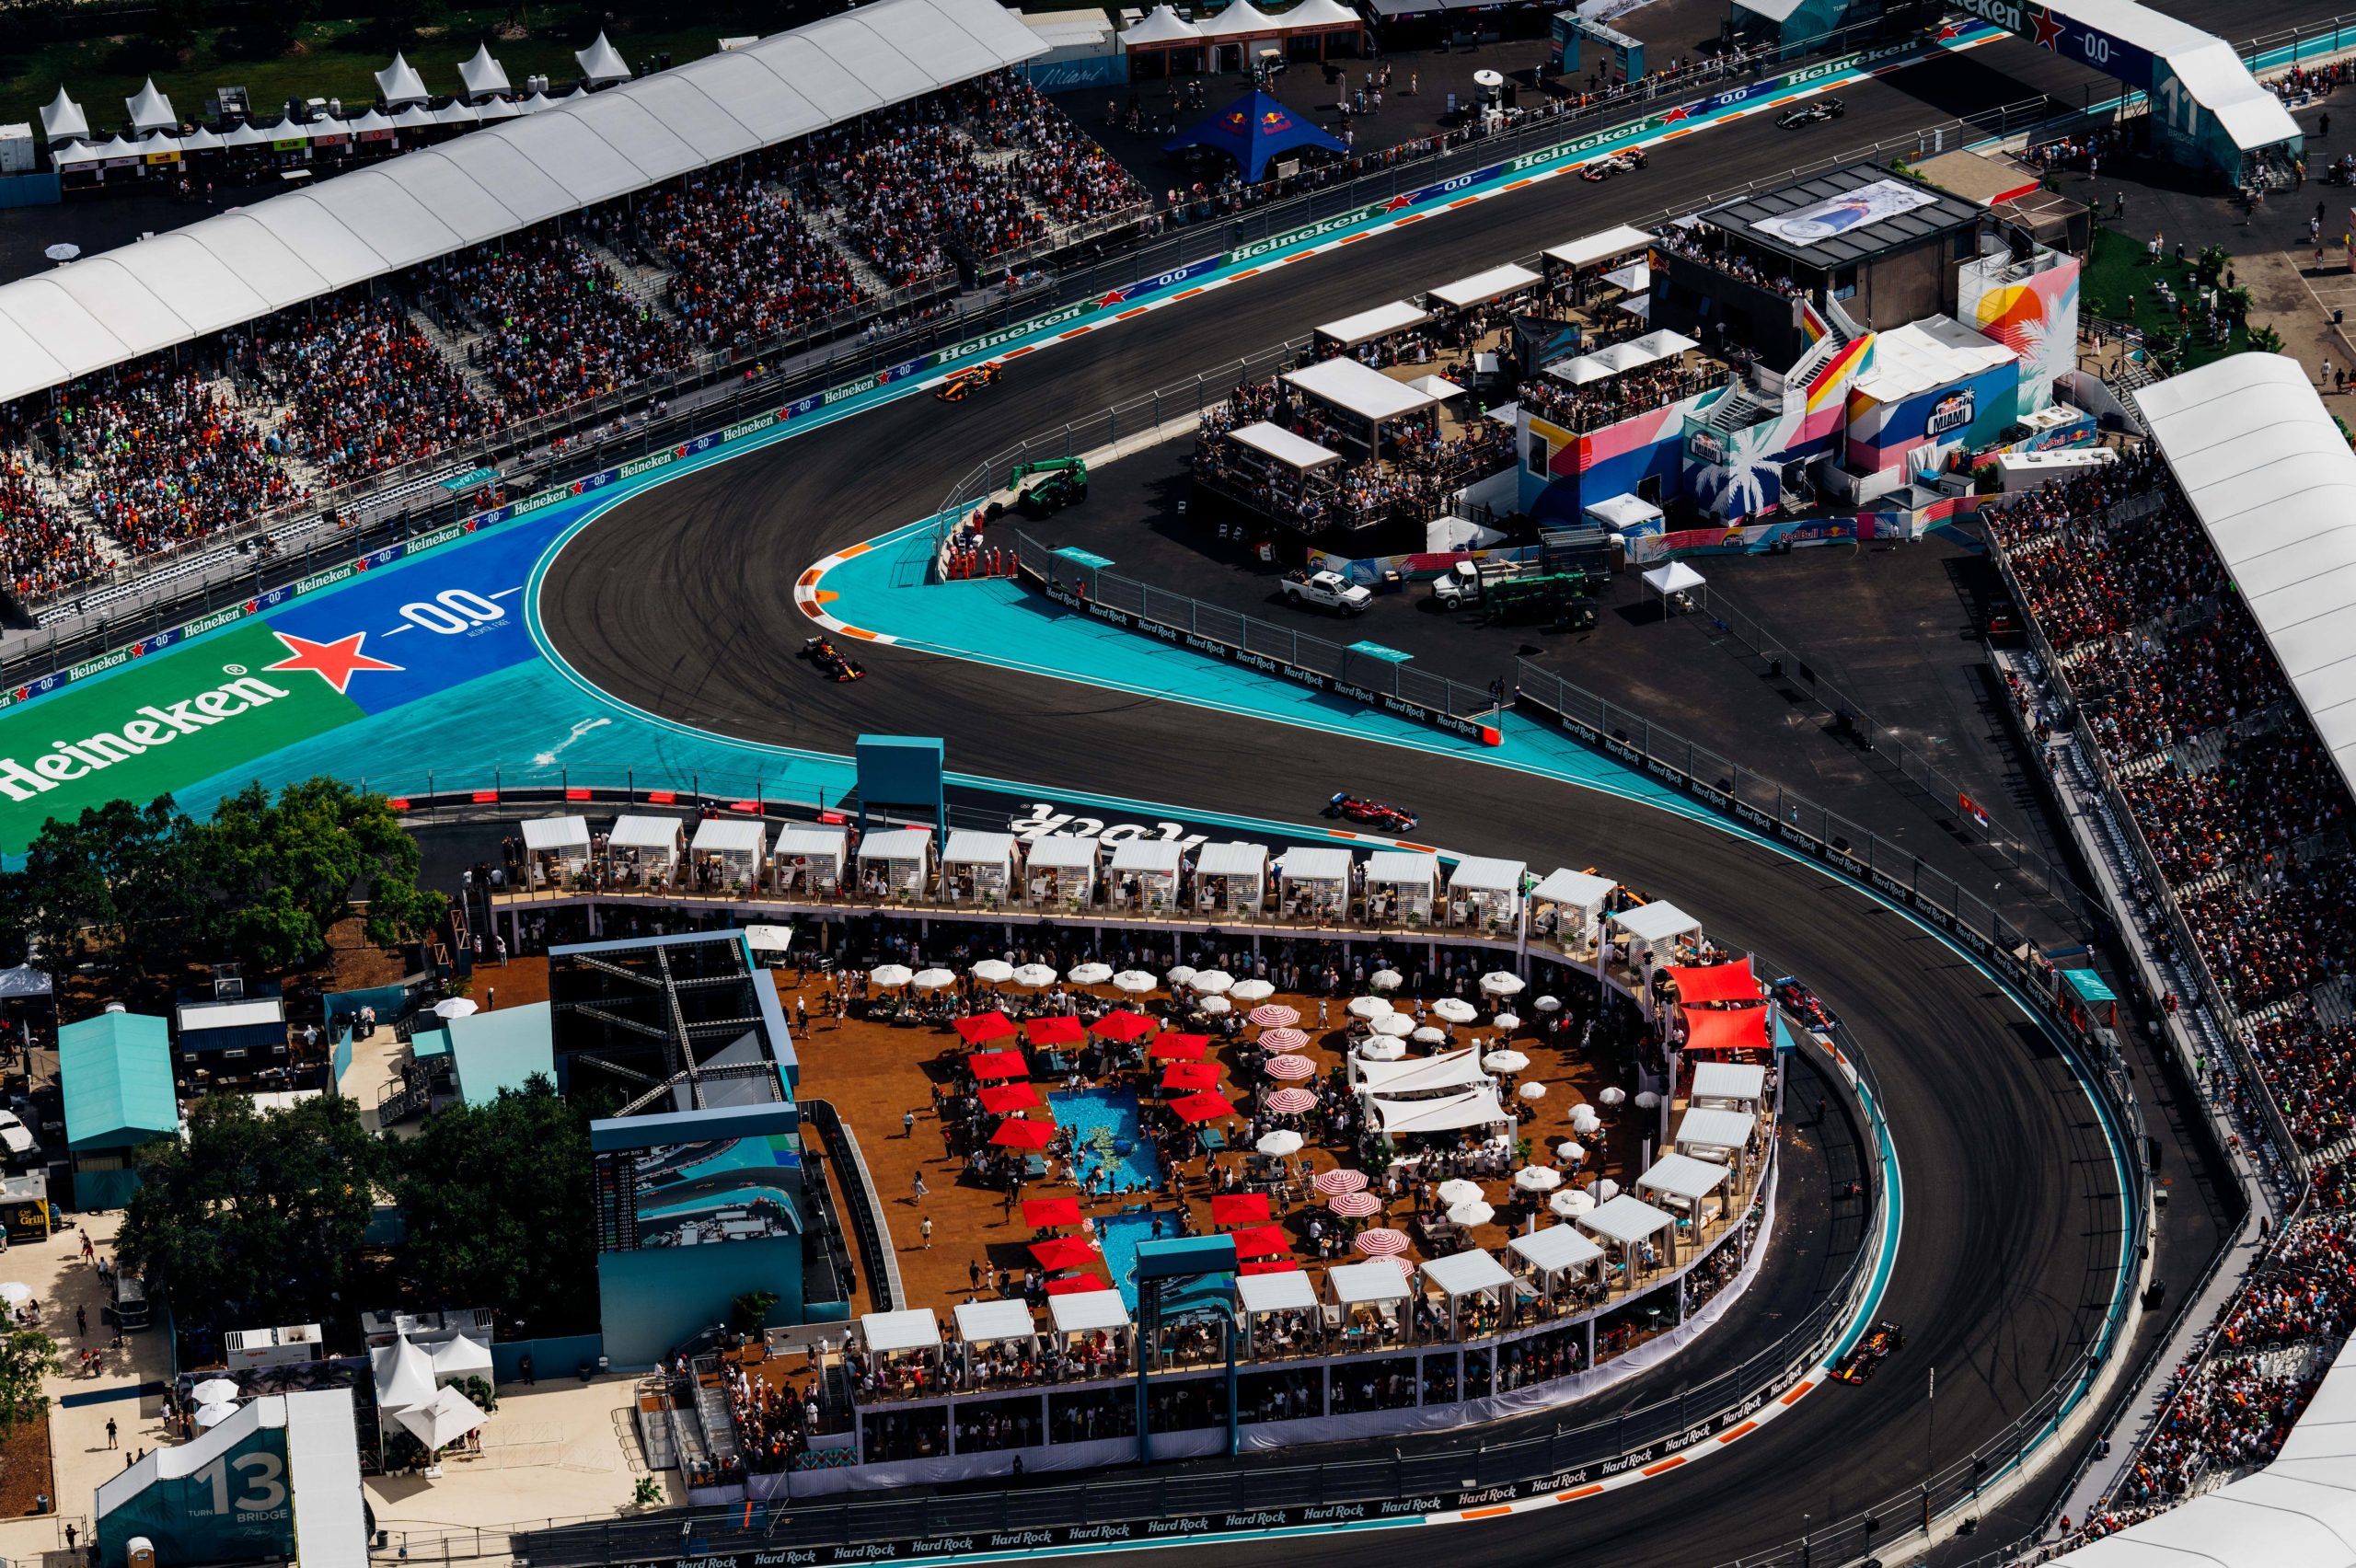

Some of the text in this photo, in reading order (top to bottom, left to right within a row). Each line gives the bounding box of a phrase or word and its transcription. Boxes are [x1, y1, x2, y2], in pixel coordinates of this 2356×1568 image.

[1832, 3, 1880, 18] TURN BRIDGE
[2084, 32, 2109, 63] 0.0
[1788, 40, 1918, 86] Heineken
[1036, 67, 1103, 90] Miami
[1513, 89, 1747, 171] Heineken 0.0
[2167, 128, 2195, 147] BRIDGE
[1230, 176, 1472, 264] Heineken 0.0
[939, 269, 1187, 364] Heineken 0.0
[825, 379, 874, 405] Heineken
[723, 416, 774, 443] Heineken
[1934, 407, 1966, 433] MIAMI
[2037, 435, 2065, 451] Red Bull
[620, 453, 672, 479] Heineken
[514, 488, 568, 516] Heineken
[407, 527, 460, 555] Heineken
[1780, 529, 1818, 541] Red Bull
[296, 566, 352, 595] Heineken
[1046, 586, 1080, 610] Hard Rock
[184, 608, 240, 640] Heineken
[399, 589, 505, 635] 0.0
[1090, 603, 1127, 626] Hard Rock
[1138, 618, 1177, 642] Hard Rock
[1187, 635, 1226, 657] Hard Rock
[69, 651, 127, 682] Heineken
[1237, 651, 1276, 673] Hard Rock
[1284, 665, 1324, 688] Hard Rock
[1335, 681, 1375, 704] Hard Rock
[1385, 697, 1426, 721] Hard Rock
[1437, 713, 1478, 737] Hard Rock
[1563, 718, 1596, 744] Hard Rock
[1605, 739, 1640, 766] Hard Rock
[1647, 760, 1682, 787] Hard Rock
[1692, 782, 1727, 809] Hard Rock
[1736, 803, 1771, 831] Hard Rock
[1781, 826, 1816, 854] Hard Rock
[1825, 848, 1862, 877] Hard Rock
[1872, 872, 1907, 902] Hard Rock
[1915, 896, 1947, 927] Hard Rock
[19, 1215, 45, 1227] Grill
[1723, 1395, 1761, 1426] Hard Rock
[1665, 1424, 1710, 1452] Hard Rock
[1601, 1447, 1652, 1475] Hard Rock
[189, 1451, 286, 1521] TURN 13
[1532, 1470, 1587, 1493] Hard Rock
[1381, 1497, 1441, 1514] Hard Rock
[1459, 1485, 1517, 1505] Hard Rock
[237, 1509, 288, 1524] BRIDGE
[1148, 1516, 1208, 1533] Hard Rock
[1226, 1510, 1287, 1527] Hard Rock
[1304, 1504, 1364, 1520] Hard Rock
[991, 1528, 1052, 1546] Hard Rock
[1069, 1522, 1130, 1539] Hard Rock
[755, 1549, 816, 1564] Hard Rock
[835, 1542, 895, 1559] Hard Rock
[912, 1537, 974, 1552] Hard Rock
